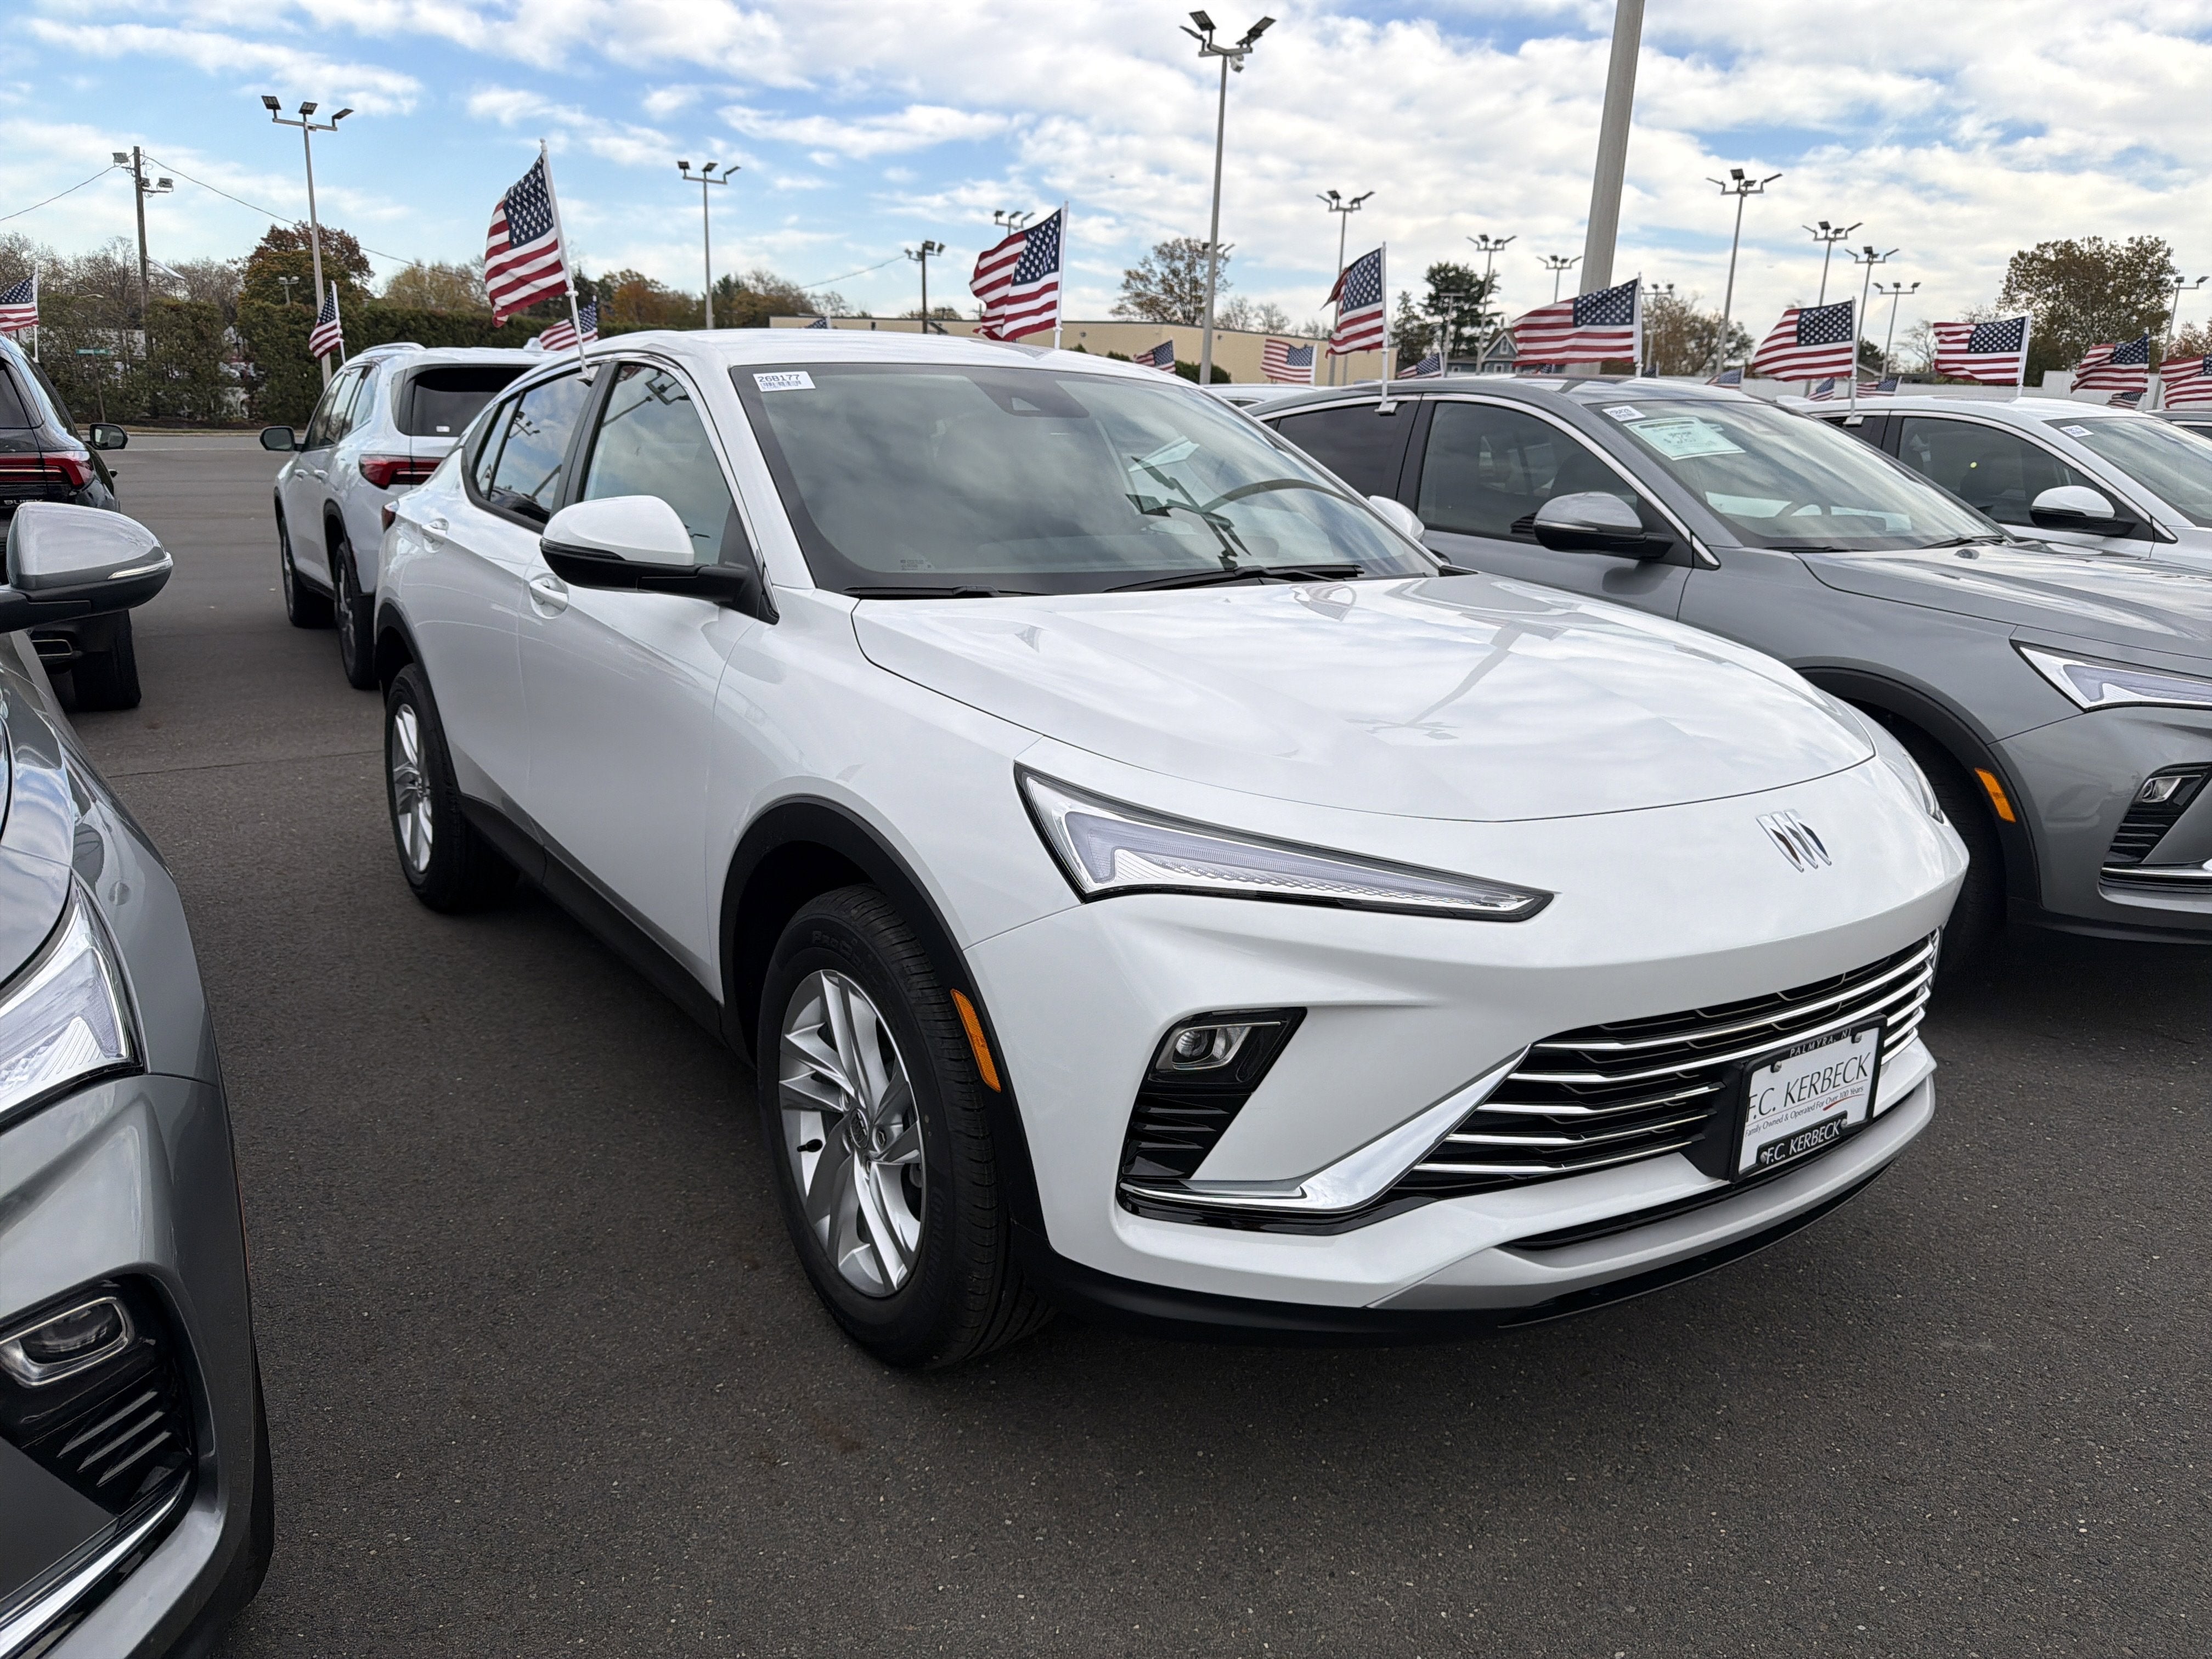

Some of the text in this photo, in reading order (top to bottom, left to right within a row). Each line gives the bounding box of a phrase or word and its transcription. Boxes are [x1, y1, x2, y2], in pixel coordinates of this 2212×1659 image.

[757, 374, 800, 382] 26B177
[1784, 1052, 1871, 1108] KERBECK
[1745, 1124, 1762, 1137] Family
[1762, 1115, 1784, 1129] Owned
[1790, 1103, 1815, 1119] Operated
[1815, 1101, 1824, 1109] For
[1825, 1096, 1838, 1104] Over
[1839, 1090, 1849, 1098] 100
[1850, 1086, 1864, 1095] Years
[1766, 1118, 1842, 1165] F.C. KERBECK
